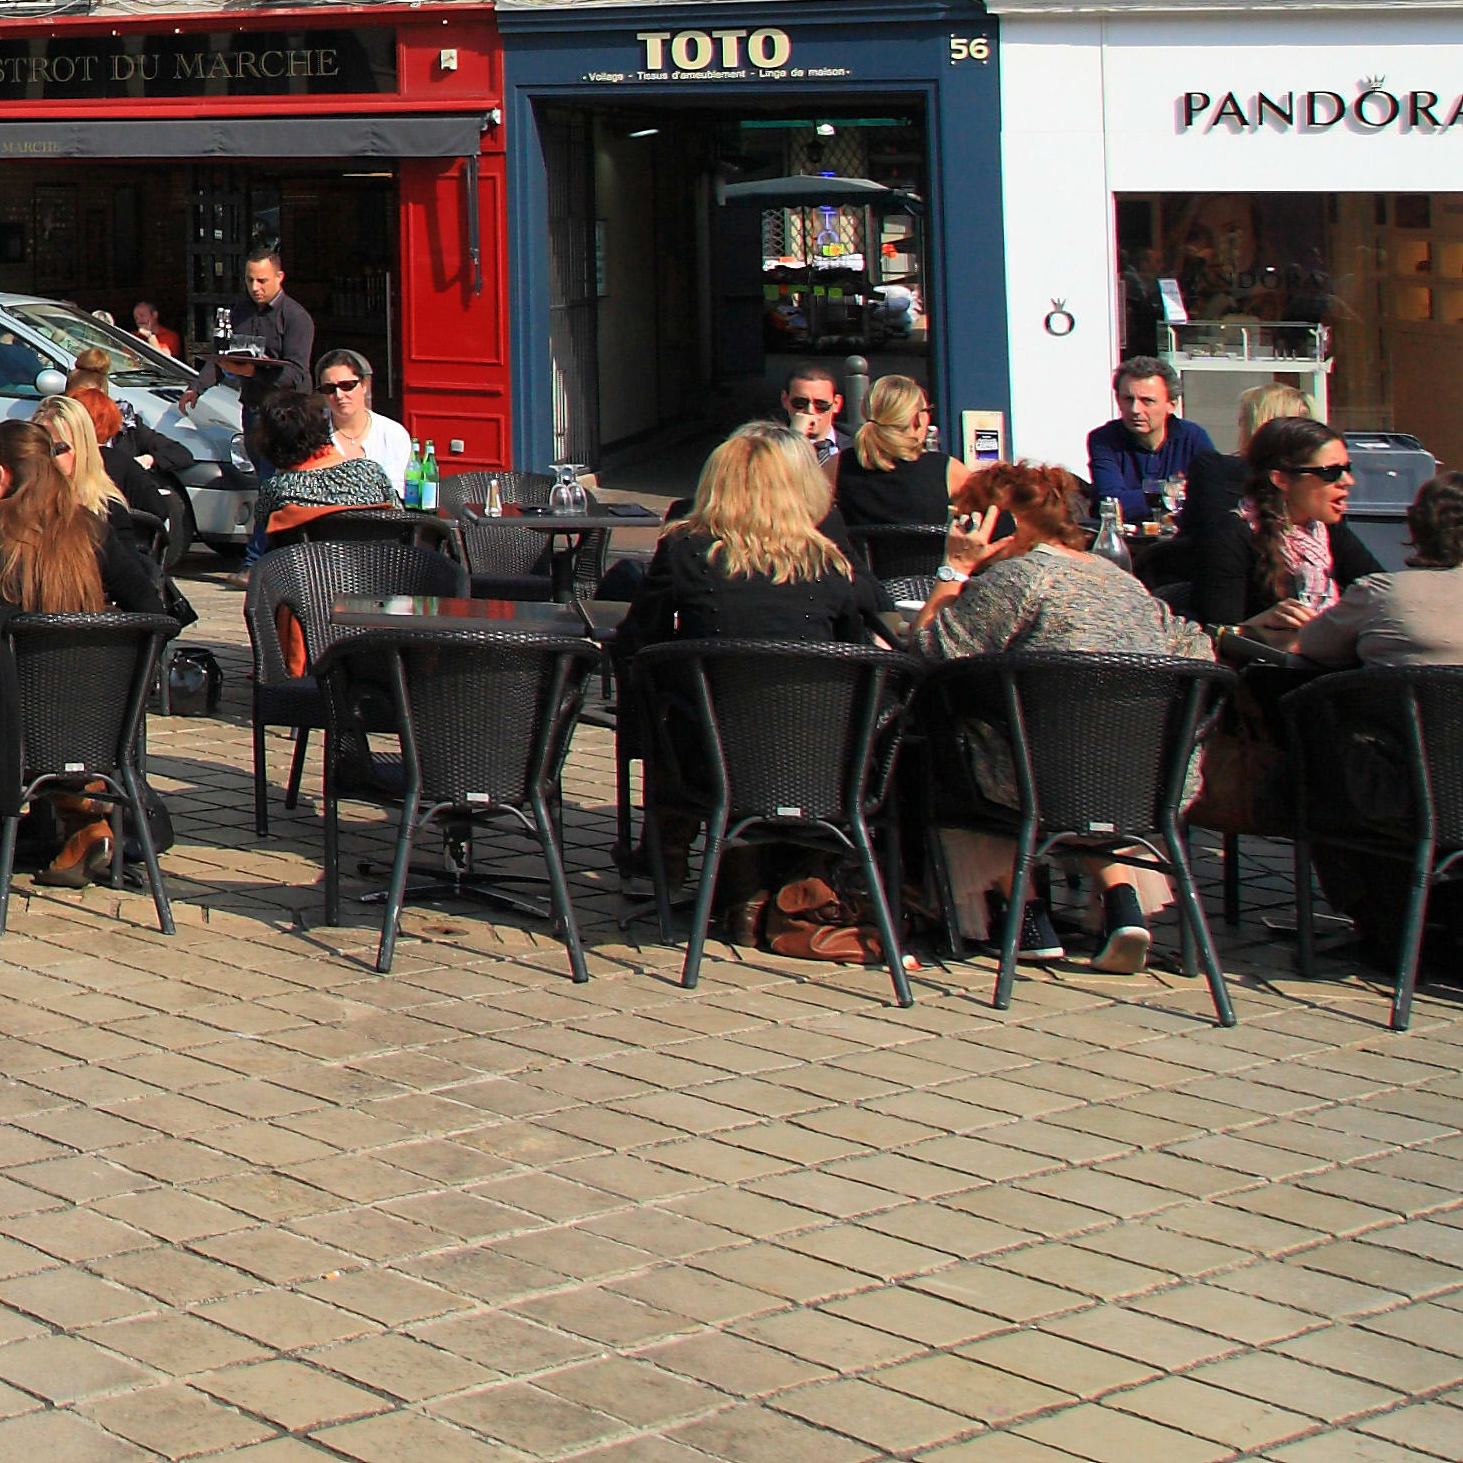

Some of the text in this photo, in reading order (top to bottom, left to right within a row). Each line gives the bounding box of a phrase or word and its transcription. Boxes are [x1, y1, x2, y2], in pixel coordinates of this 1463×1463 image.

[636, 27, 792, 70] TOTO
[951, 37, 990, 60] 56
[110, 53, 161, 81] DU
[173, 49, 339, 80] MARCHE
